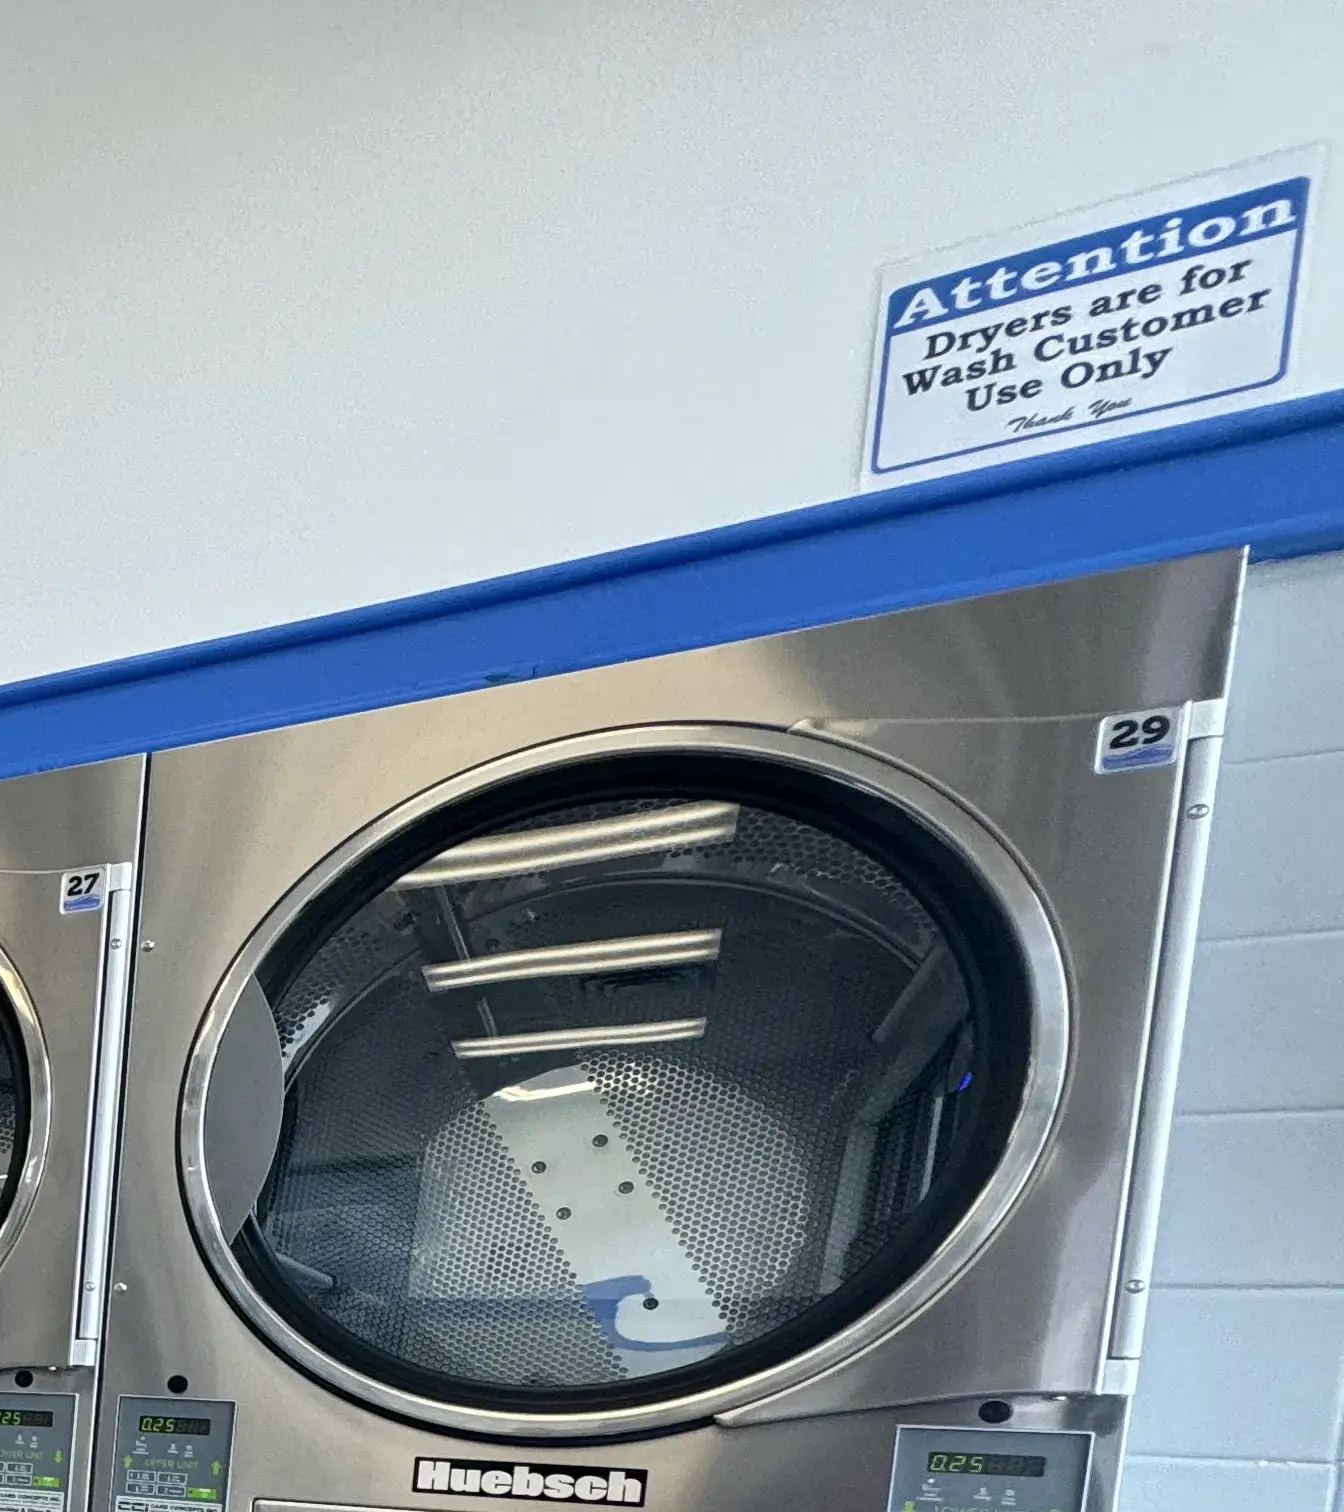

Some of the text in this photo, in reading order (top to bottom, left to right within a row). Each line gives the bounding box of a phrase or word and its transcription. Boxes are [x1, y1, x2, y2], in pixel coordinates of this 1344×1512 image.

[894, 198, 1297, 329] Attention
[922, 259, 1253, 361] Dryers are for
[902, 289, 1272, 397] Wash Customer
[965, 348, 1174, 412] Use Only
[1006, 397, 1134, 433] Thank You
[1110, 715, 1170, 749] 29
[67, 872, 100, 896] 27
[141, 1417, 175, 1432] 0.25
[416, 1460, 642, 1503] Huebsch
[930, 1454, 984, 1473] 0.25
